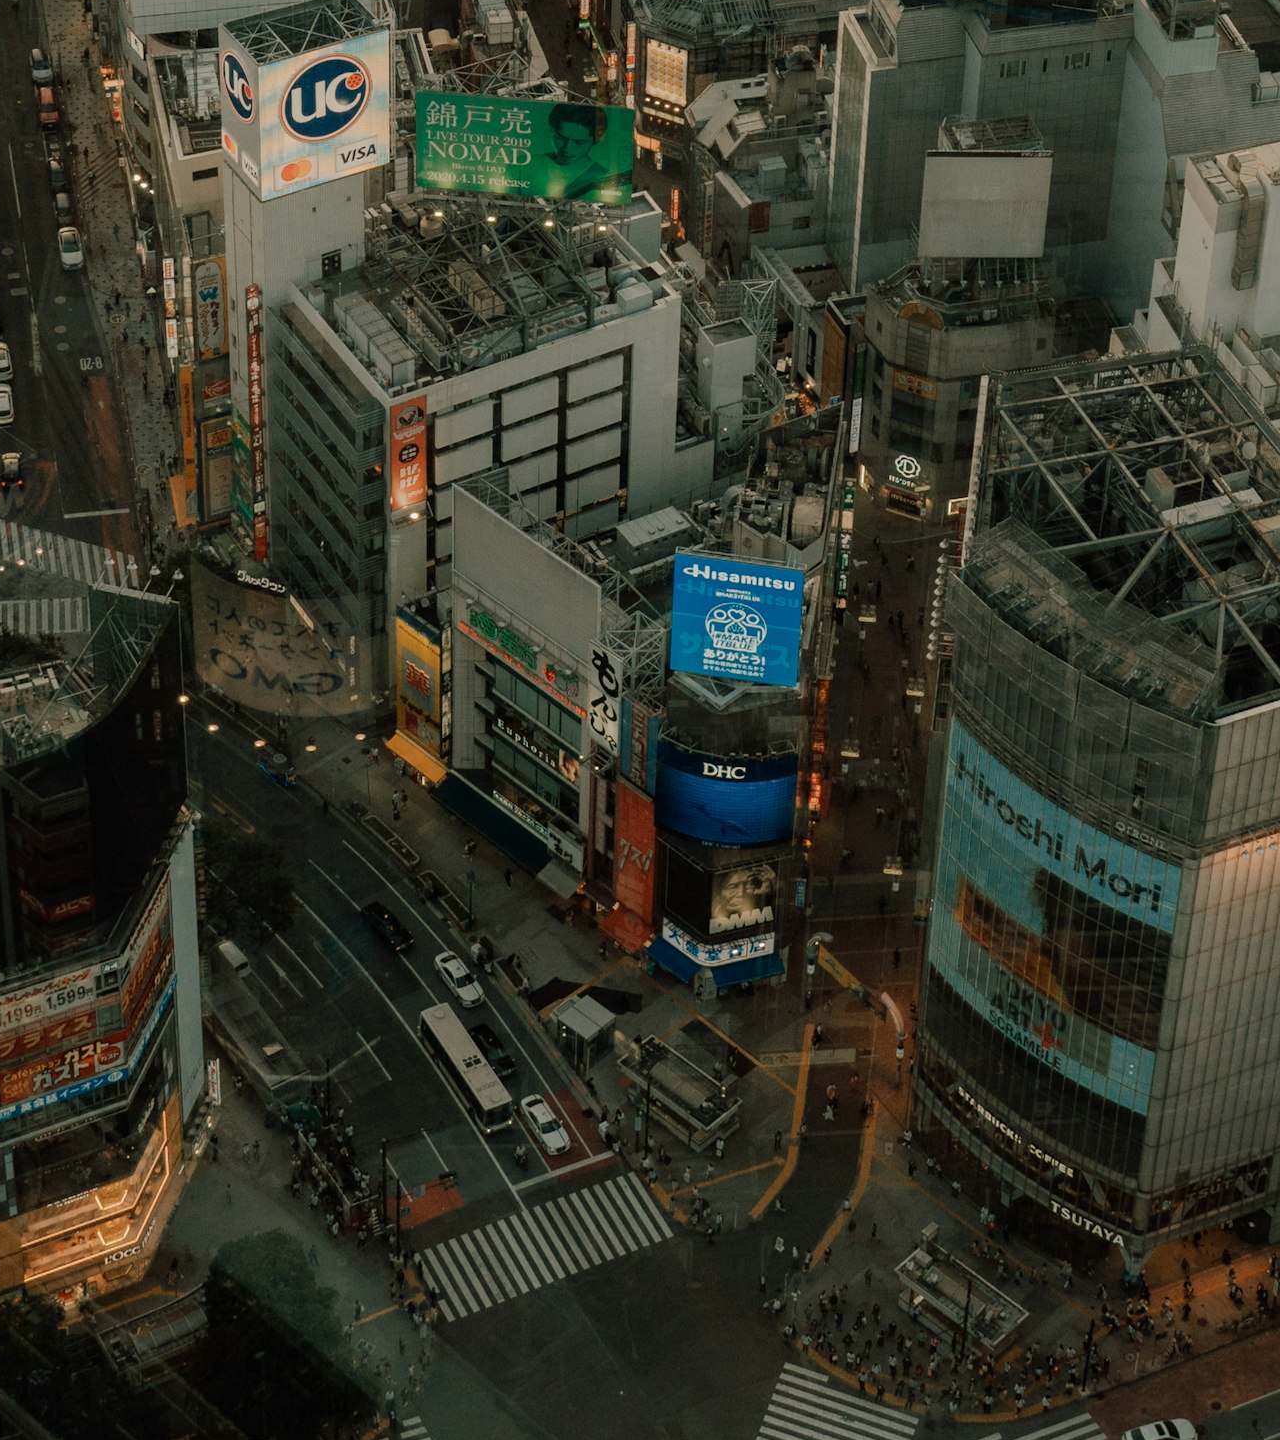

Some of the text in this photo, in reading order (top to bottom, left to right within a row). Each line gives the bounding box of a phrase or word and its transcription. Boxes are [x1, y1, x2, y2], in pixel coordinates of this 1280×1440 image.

[426, 100, 532, 135] 錦戸亮
[426, 130, 532, 148] LIVE TOUR 2019
[428, 141, 532, 166] NOMAD
[340, 144, 377, 164] VISA
[427, 171, 530, 189] 2020.4.15 release
[237, 570, 286, 593] グルメタウン
[683, 564, 796, 591] Hisamitsu
[591, 649, 620, 752] もんじゃ
[496, 717, 558, 769] Euphoria
[702, 762, 747, 780] DHC
[953, 753, 1157, 913] Hiroshi Mori
[709, 905, 774, 934] DMM
[997, 970, 1064, 1031] TOKYO
[63, 1041, 109, 1068] ガスト
[988, 1010, 1061, 1072] SCRAMBLE
[31, 1062, 91, 1092] ガスト
[956, 1086, 1072, 1179] STARBUCKS COFFEE
[1049, 1199, 1126, 1246] TSUTAYA
